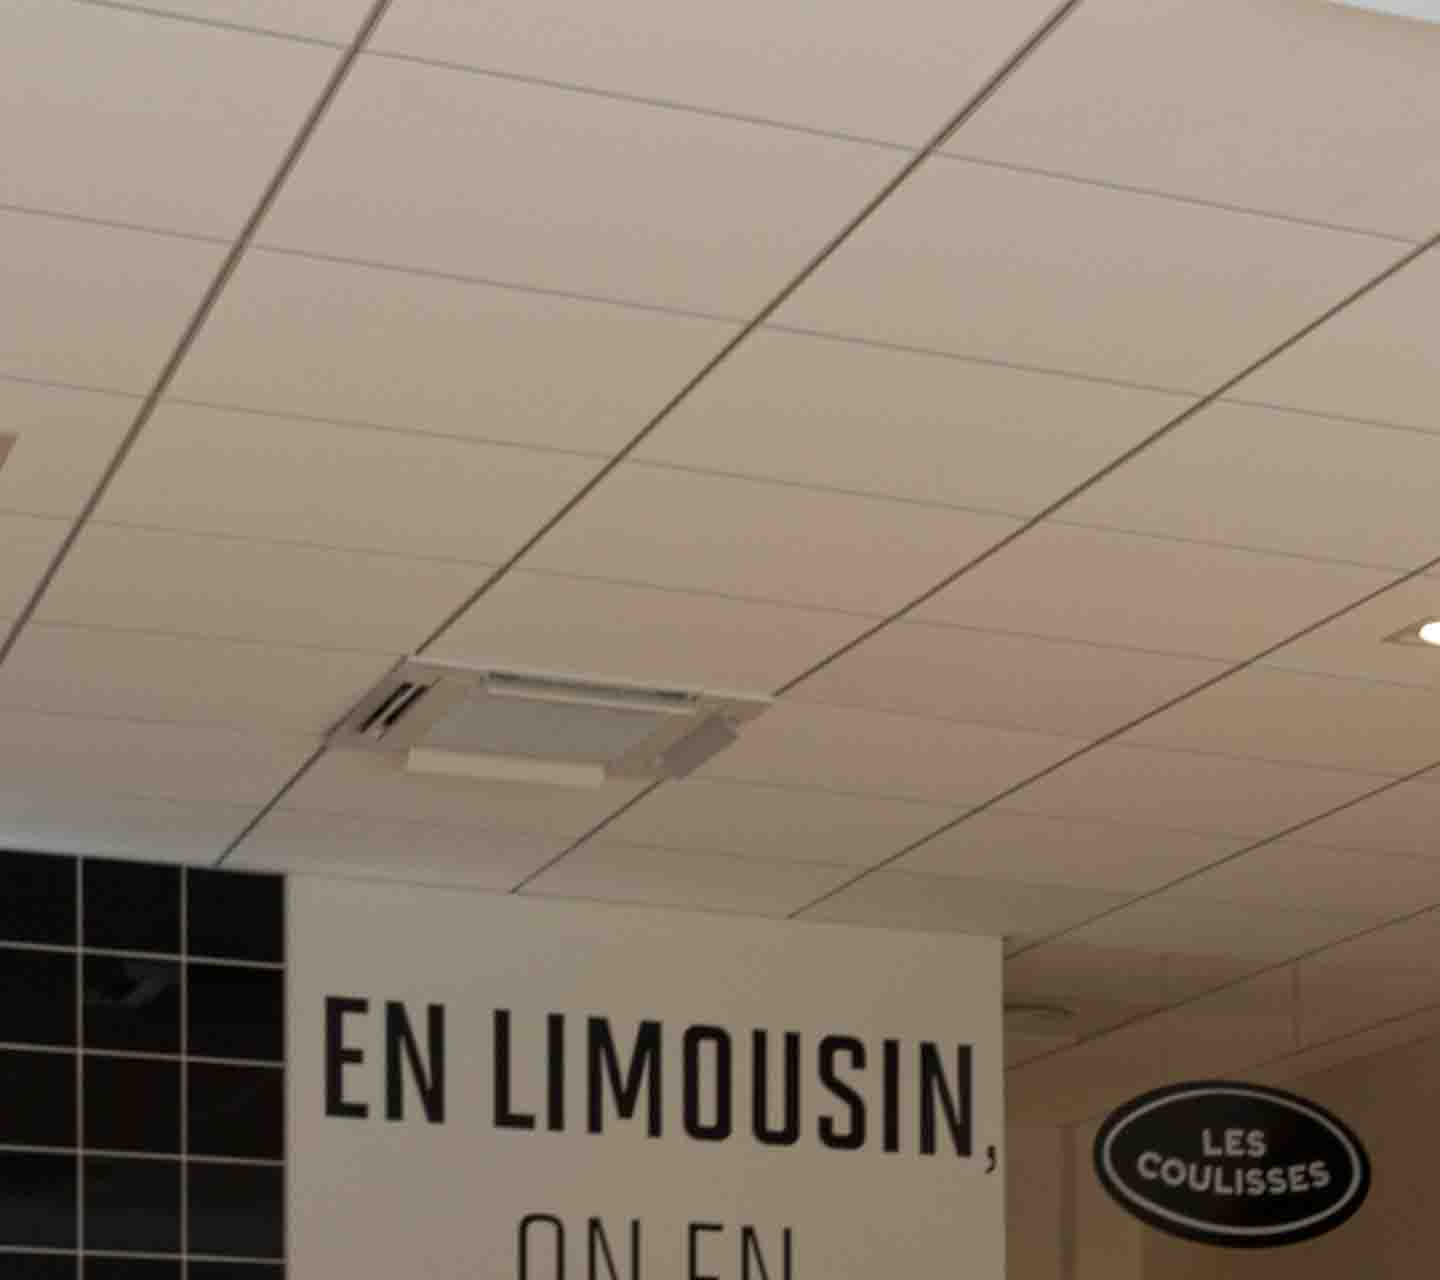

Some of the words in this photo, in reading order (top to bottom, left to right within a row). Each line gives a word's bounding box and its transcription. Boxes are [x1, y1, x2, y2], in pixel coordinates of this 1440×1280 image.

[324, 994, 447, 1125] EN
[492, 1008, 999, 1175] LIMOUSIN,
[1201, 1127, 1267, 1157] LES
[1136, 1151, 1332, 1197] COULISSES
